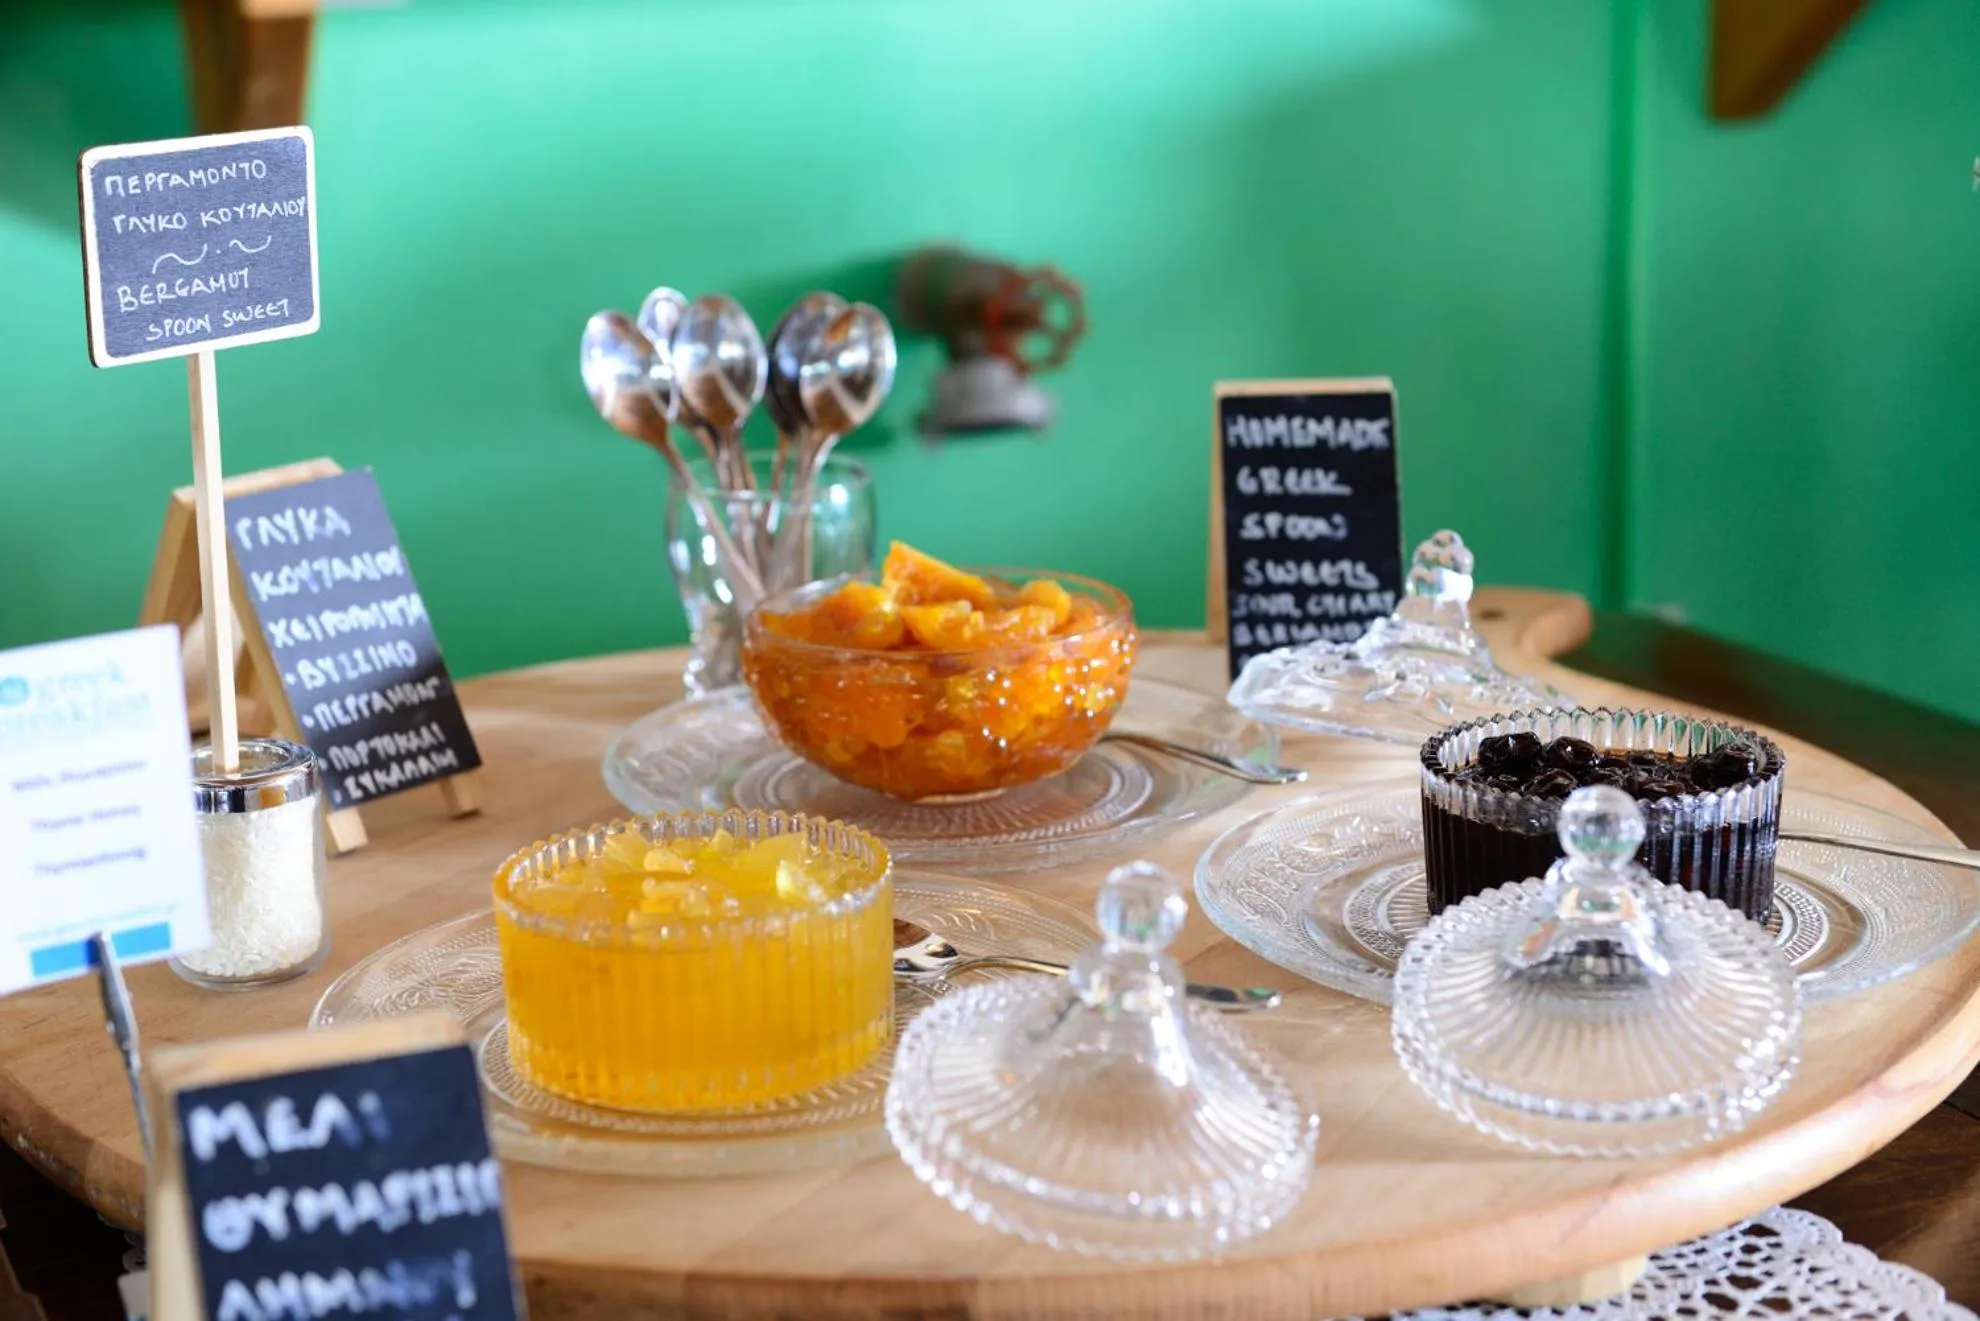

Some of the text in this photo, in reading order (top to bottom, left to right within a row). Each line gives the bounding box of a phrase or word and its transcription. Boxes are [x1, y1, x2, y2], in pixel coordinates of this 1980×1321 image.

[113, 196, 306, 234] ΓΛΥΚΟ ΚΟΥΤΑΛΙΟΥ
[146, 298, 289, 341] SPOON SWEET
[1226, 414, 1391, 450] HOMEMADE
[1236, 466, 1354, 496] GREEK
[235, 505, 351, 550] ΓΛΥΚΑ
